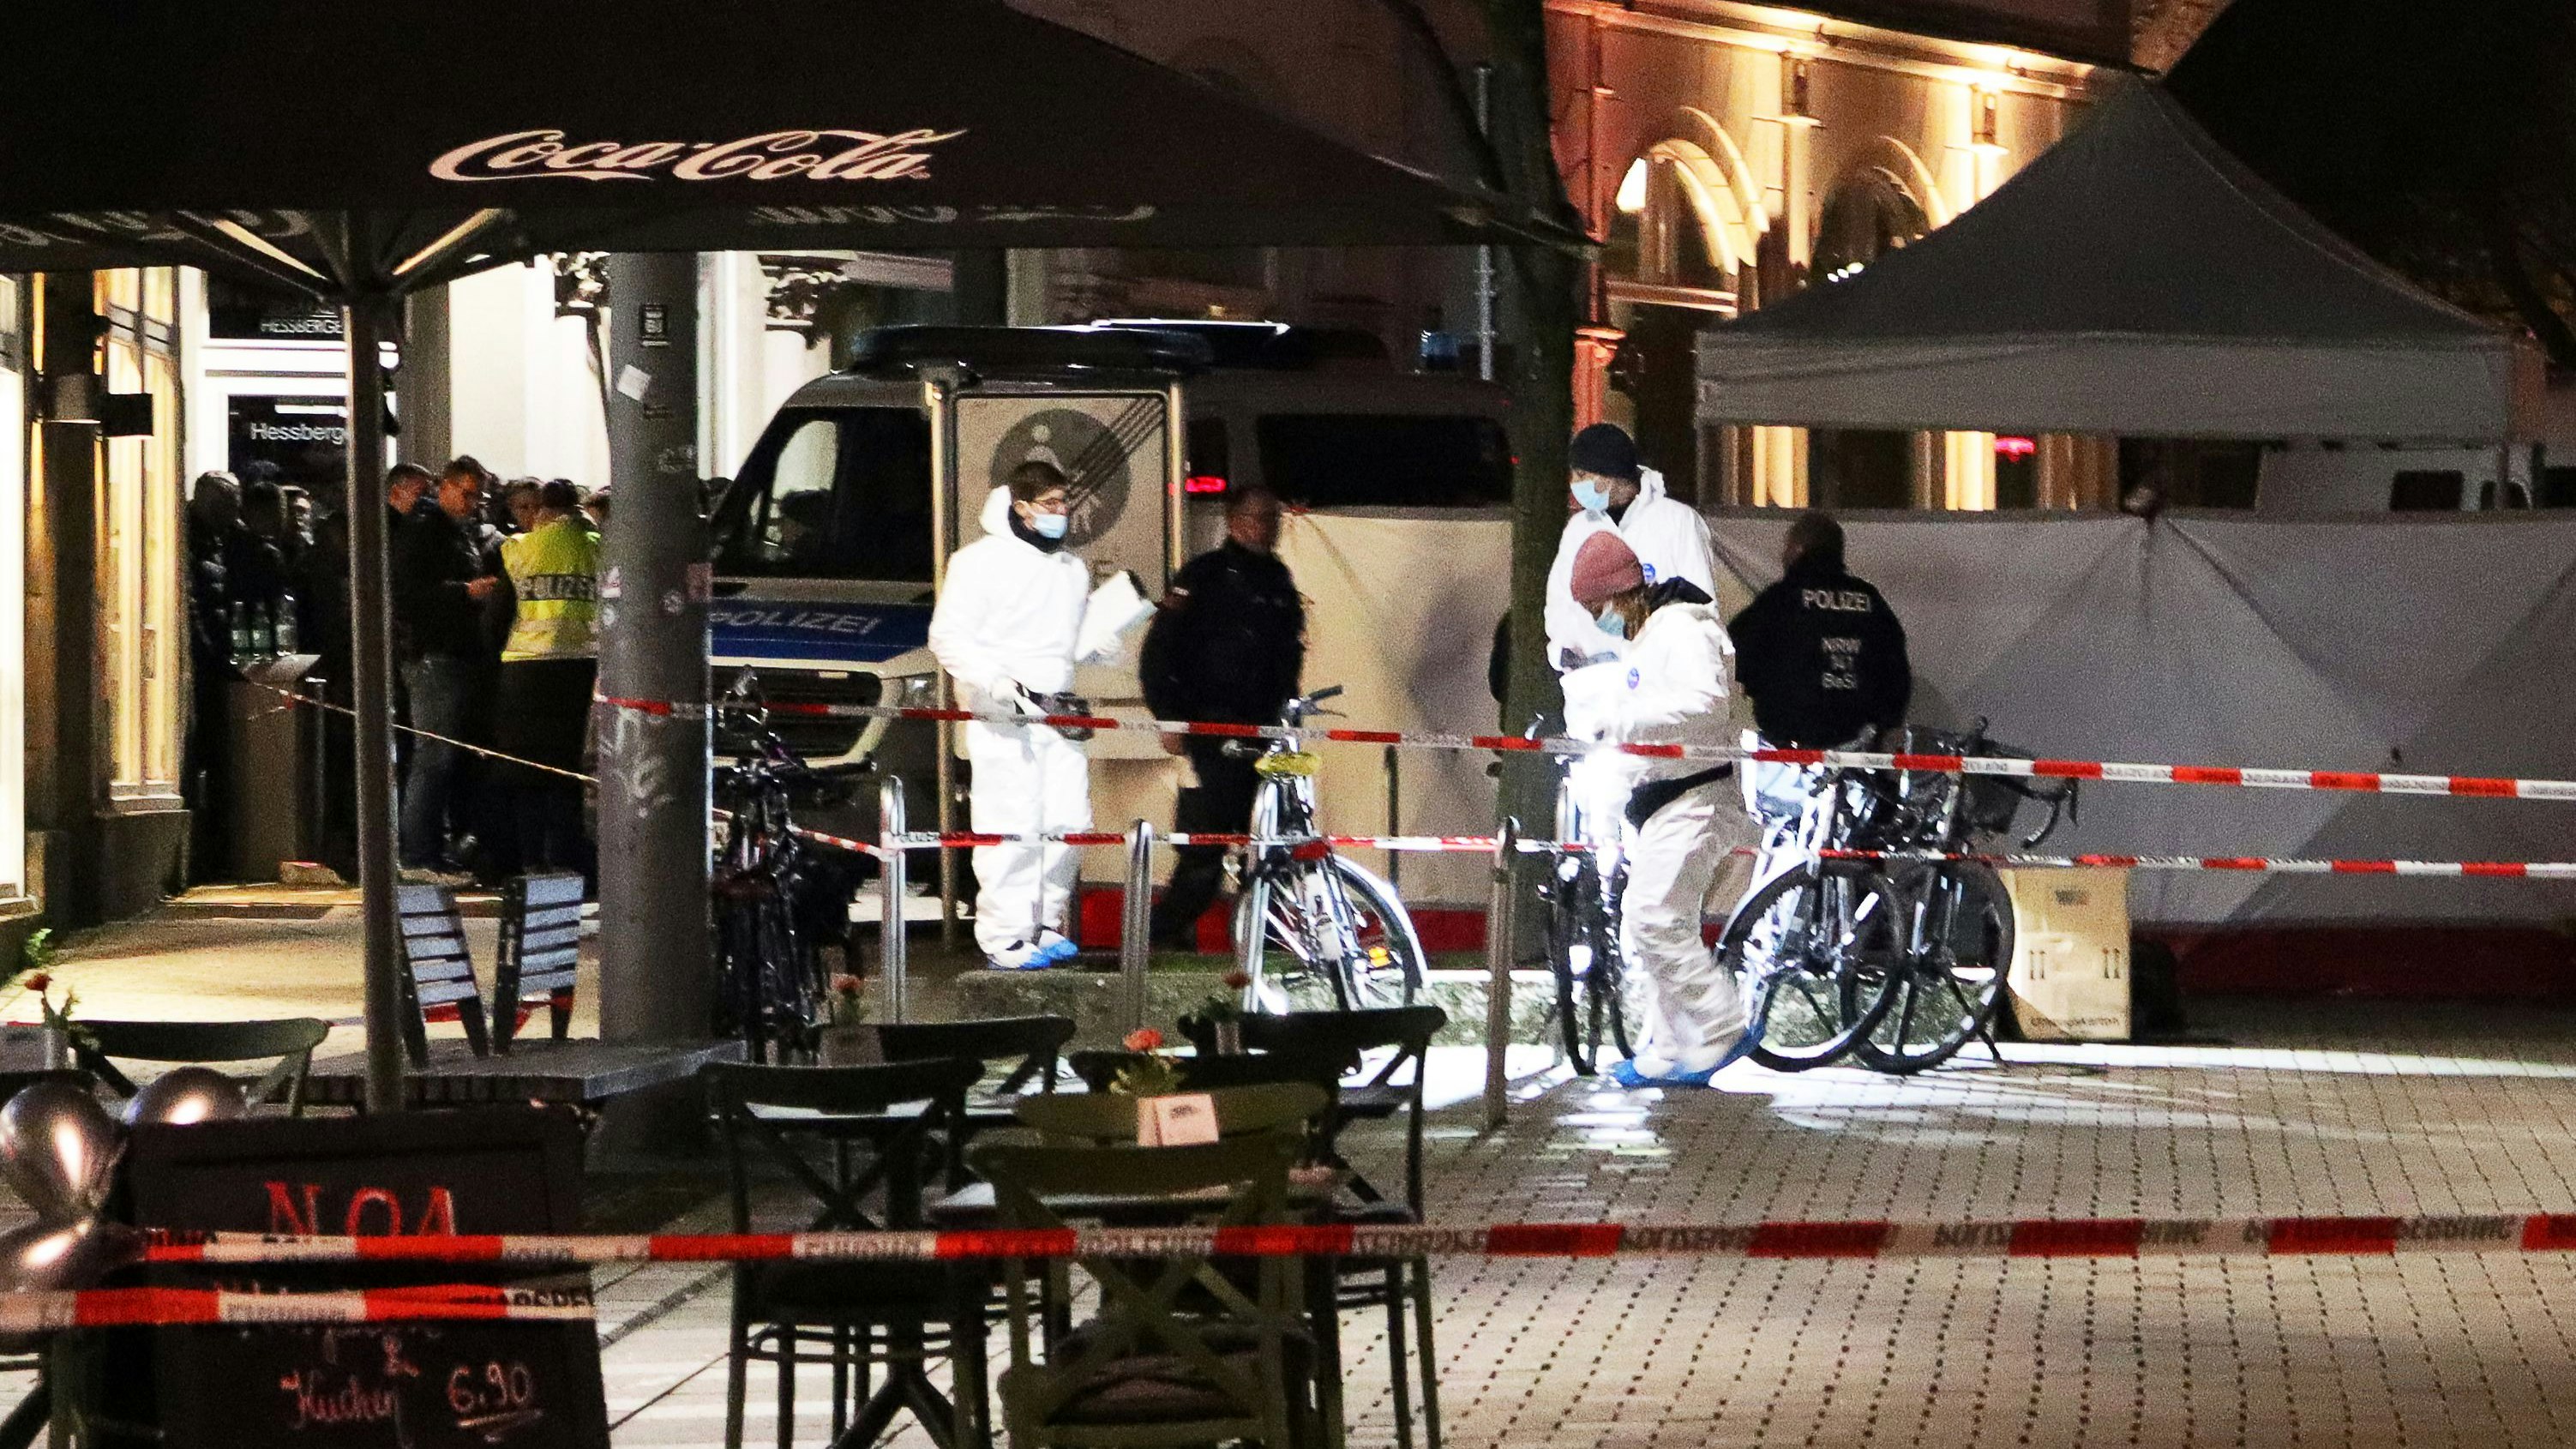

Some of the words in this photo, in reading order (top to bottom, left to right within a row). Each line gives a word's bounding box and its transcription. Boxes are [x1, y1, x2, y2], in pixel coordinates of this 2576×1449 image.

[1802, 588, 1872, 613] POLIZEI
[709, 610, 882, 635] POLIZEI
[447, 1362, 531, 1413] 6.90
